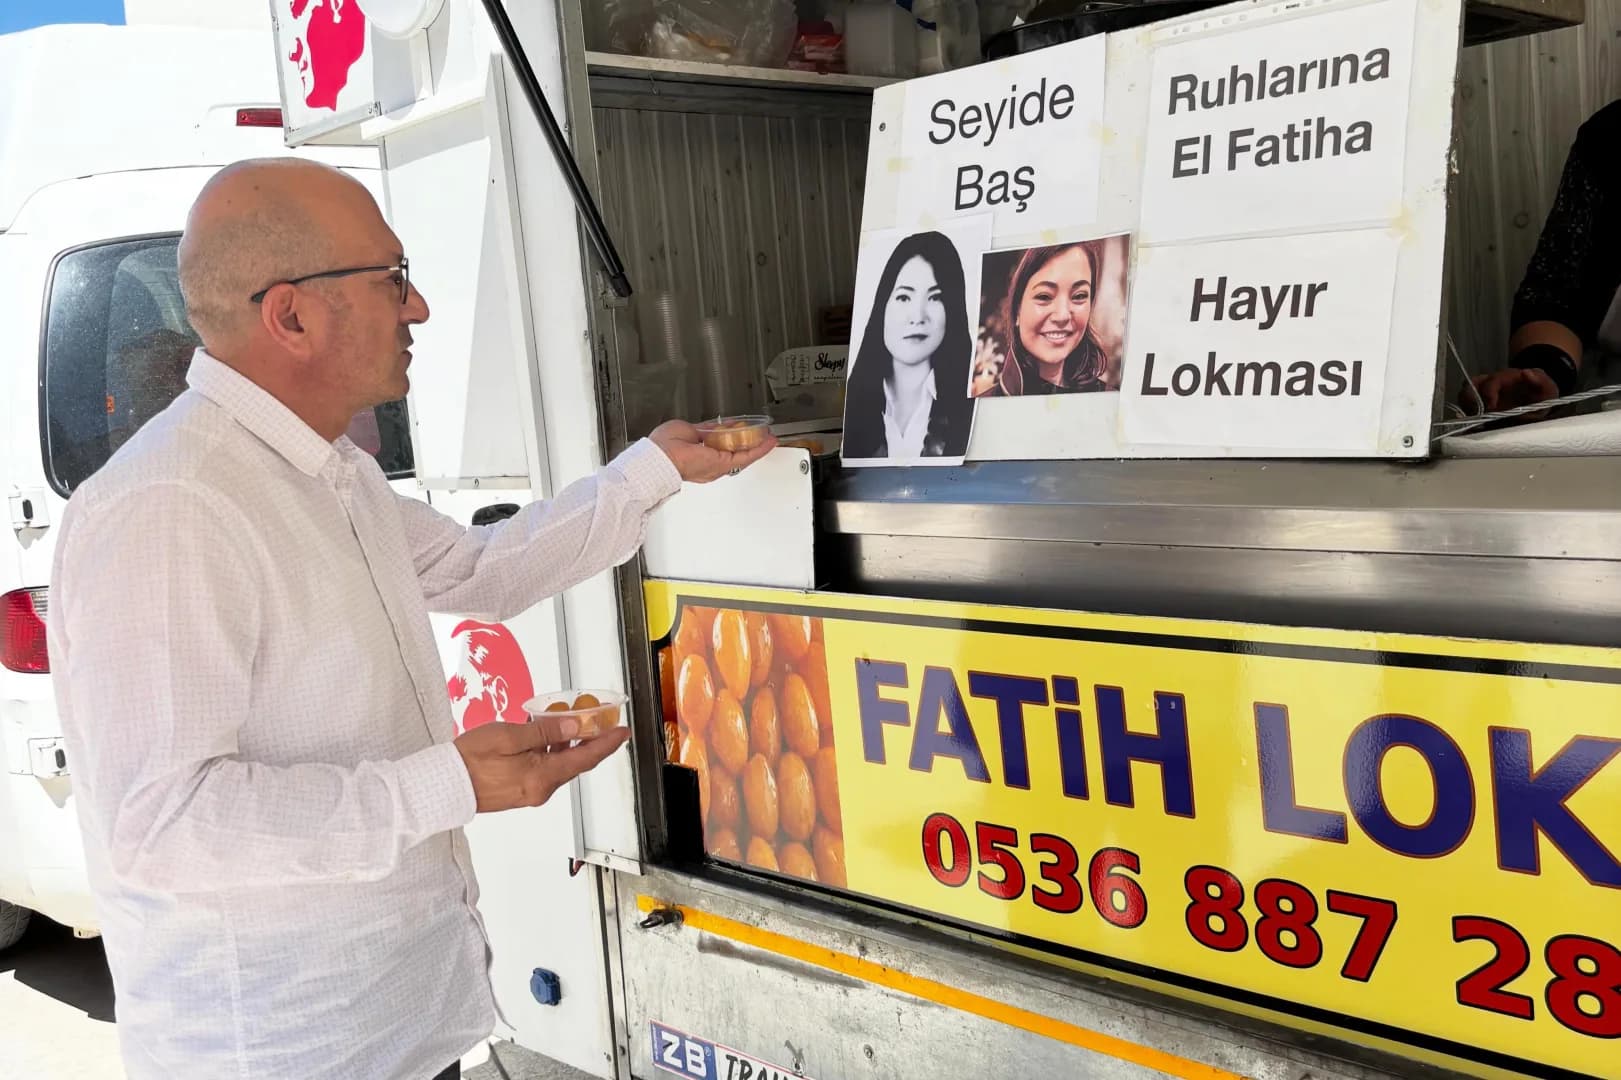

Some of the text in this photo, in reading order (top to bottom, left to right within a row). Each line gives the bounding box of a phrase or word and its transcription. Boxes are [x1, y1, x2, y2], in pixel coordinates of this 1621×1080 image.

[929, 77, 1074, 146] Seyide
[1169, 47, 1390, 116] Ruhlarına
[1173, 117, 1373, 178] El Fatiha
[955, 165, 1035, 212] Baş
[1190, 276, 1328, 330] Hayır
[1141, 352, 1363, 397] Lokması
[1253, 701, 1621, 889] LOK
[922, 812, 1621, 1039] 0536 887 28
[661, 1030, 707, 1077] ZB
